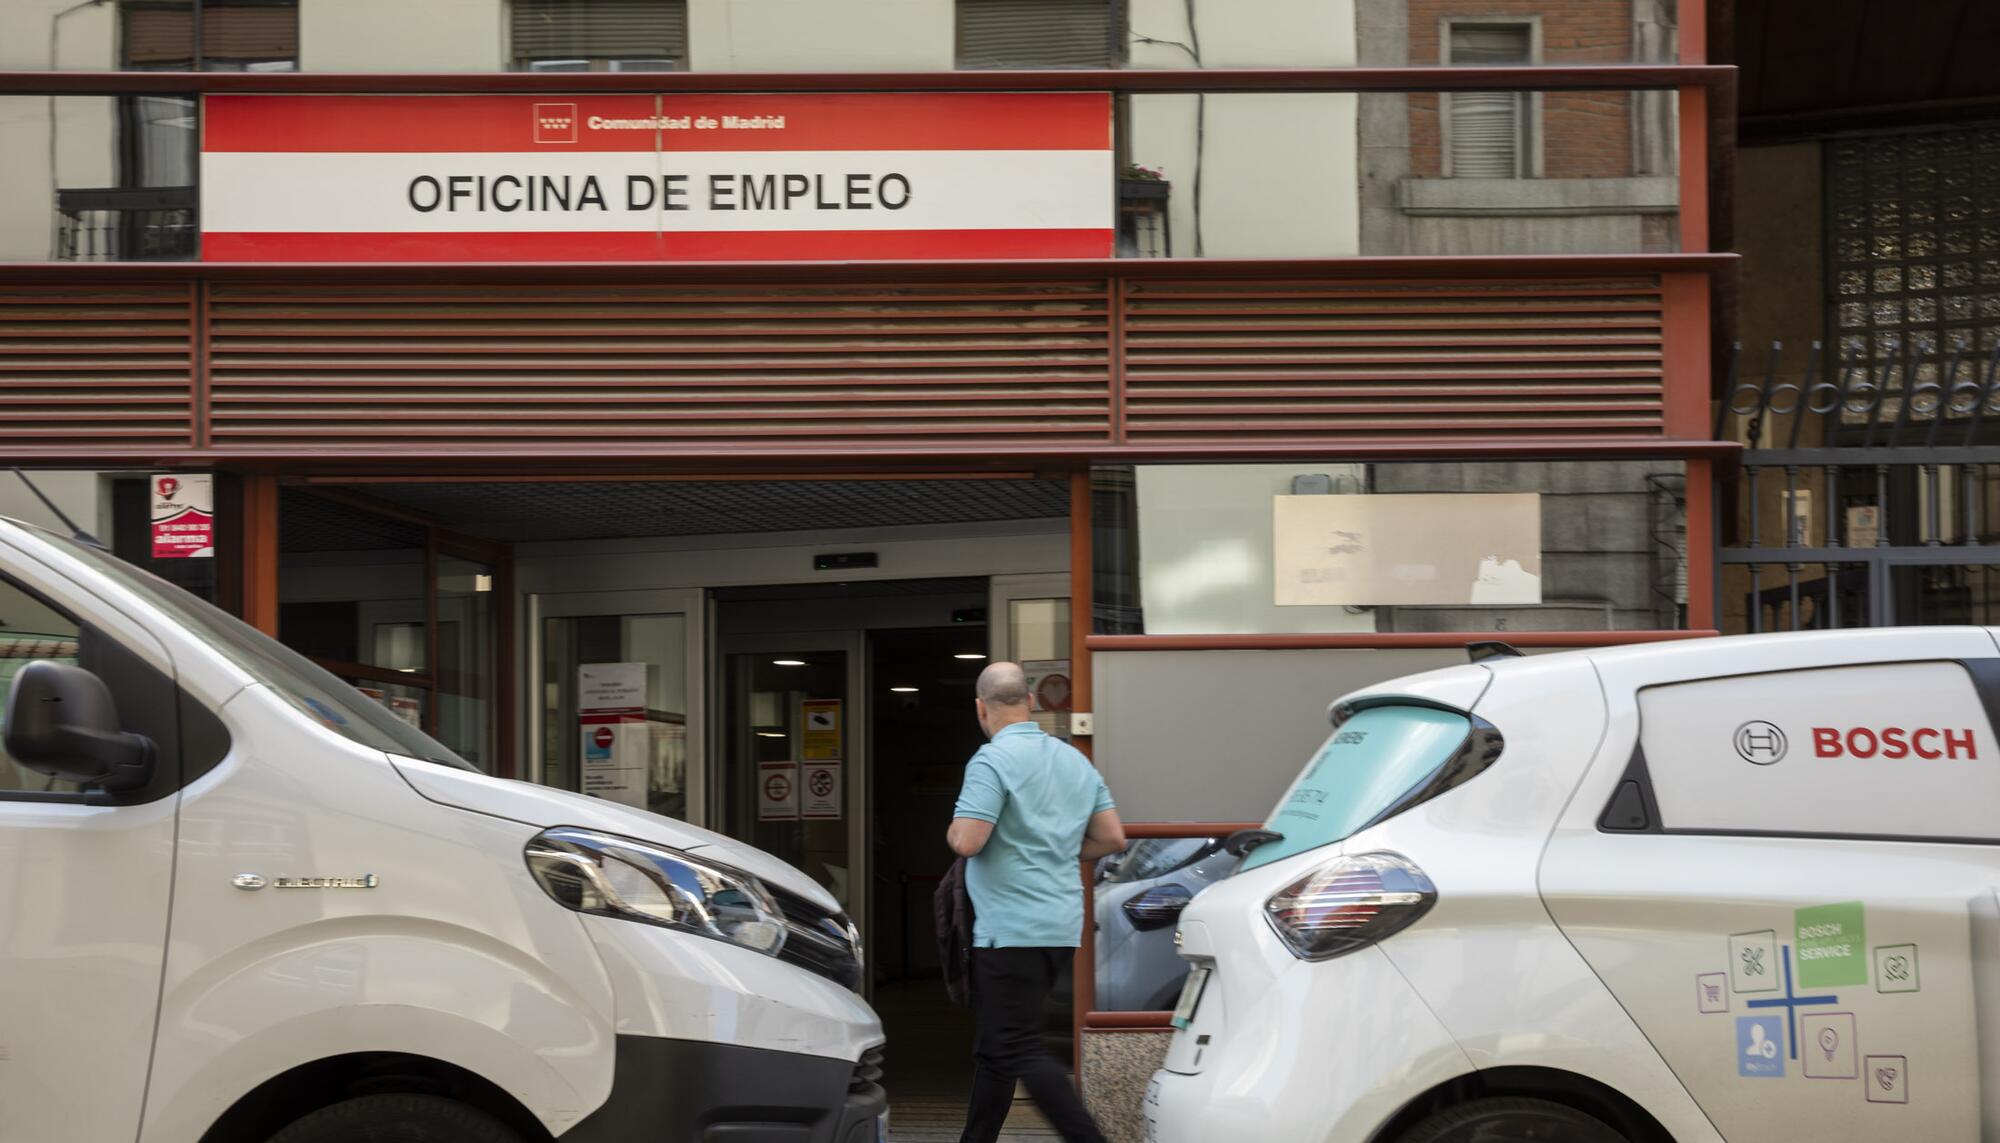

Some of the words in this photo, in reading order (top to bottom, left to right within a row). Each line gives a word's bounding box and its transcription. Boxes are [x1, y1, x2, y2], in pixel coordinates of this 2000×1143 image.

[588, 116, 691, 130] Comunidad
[694, 116, 719, 130] de
[722, 115, 786, 130] Madrid
[408, 174, 608, 213] OFICINA
[627, 174, 689, 212] DE
[709, 172, 912, 211] EMPLEO
[154, 533, 208, 544] alarma
[1811, 727, 1978, 760] BOSCH
[273, 877, 366, 889] ELECTRIC
[1799, 923, 1842, 939] BOSCH
[1800, 944, 1852, 960] SERVICE
